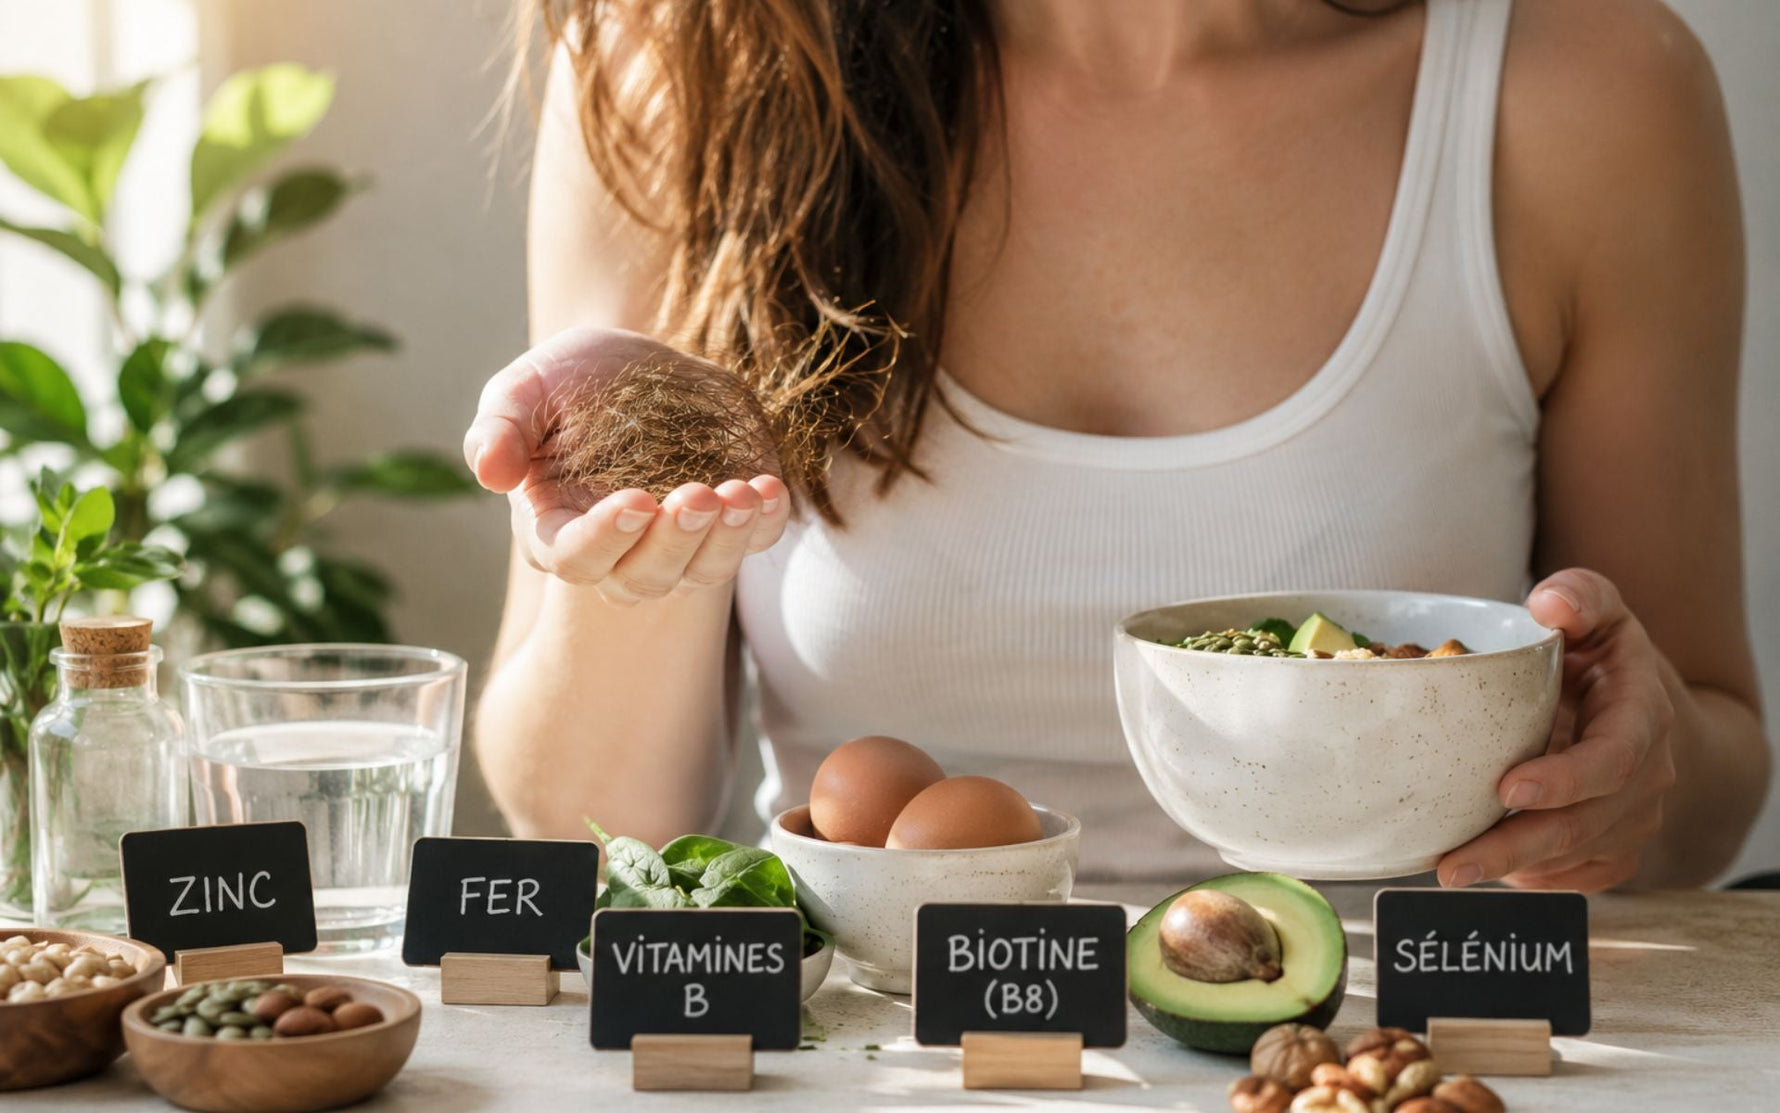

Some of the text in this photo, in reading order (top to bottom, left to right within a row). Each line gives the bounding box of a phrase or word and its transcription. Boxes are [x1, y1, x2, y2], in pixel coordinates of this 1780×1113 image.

[169, 870, 276, 917] ZINC
[460, 876, 543, 917] FER
[684, 983, 709, 1017] B
[984, 979, 1058, 1020] (B8)
